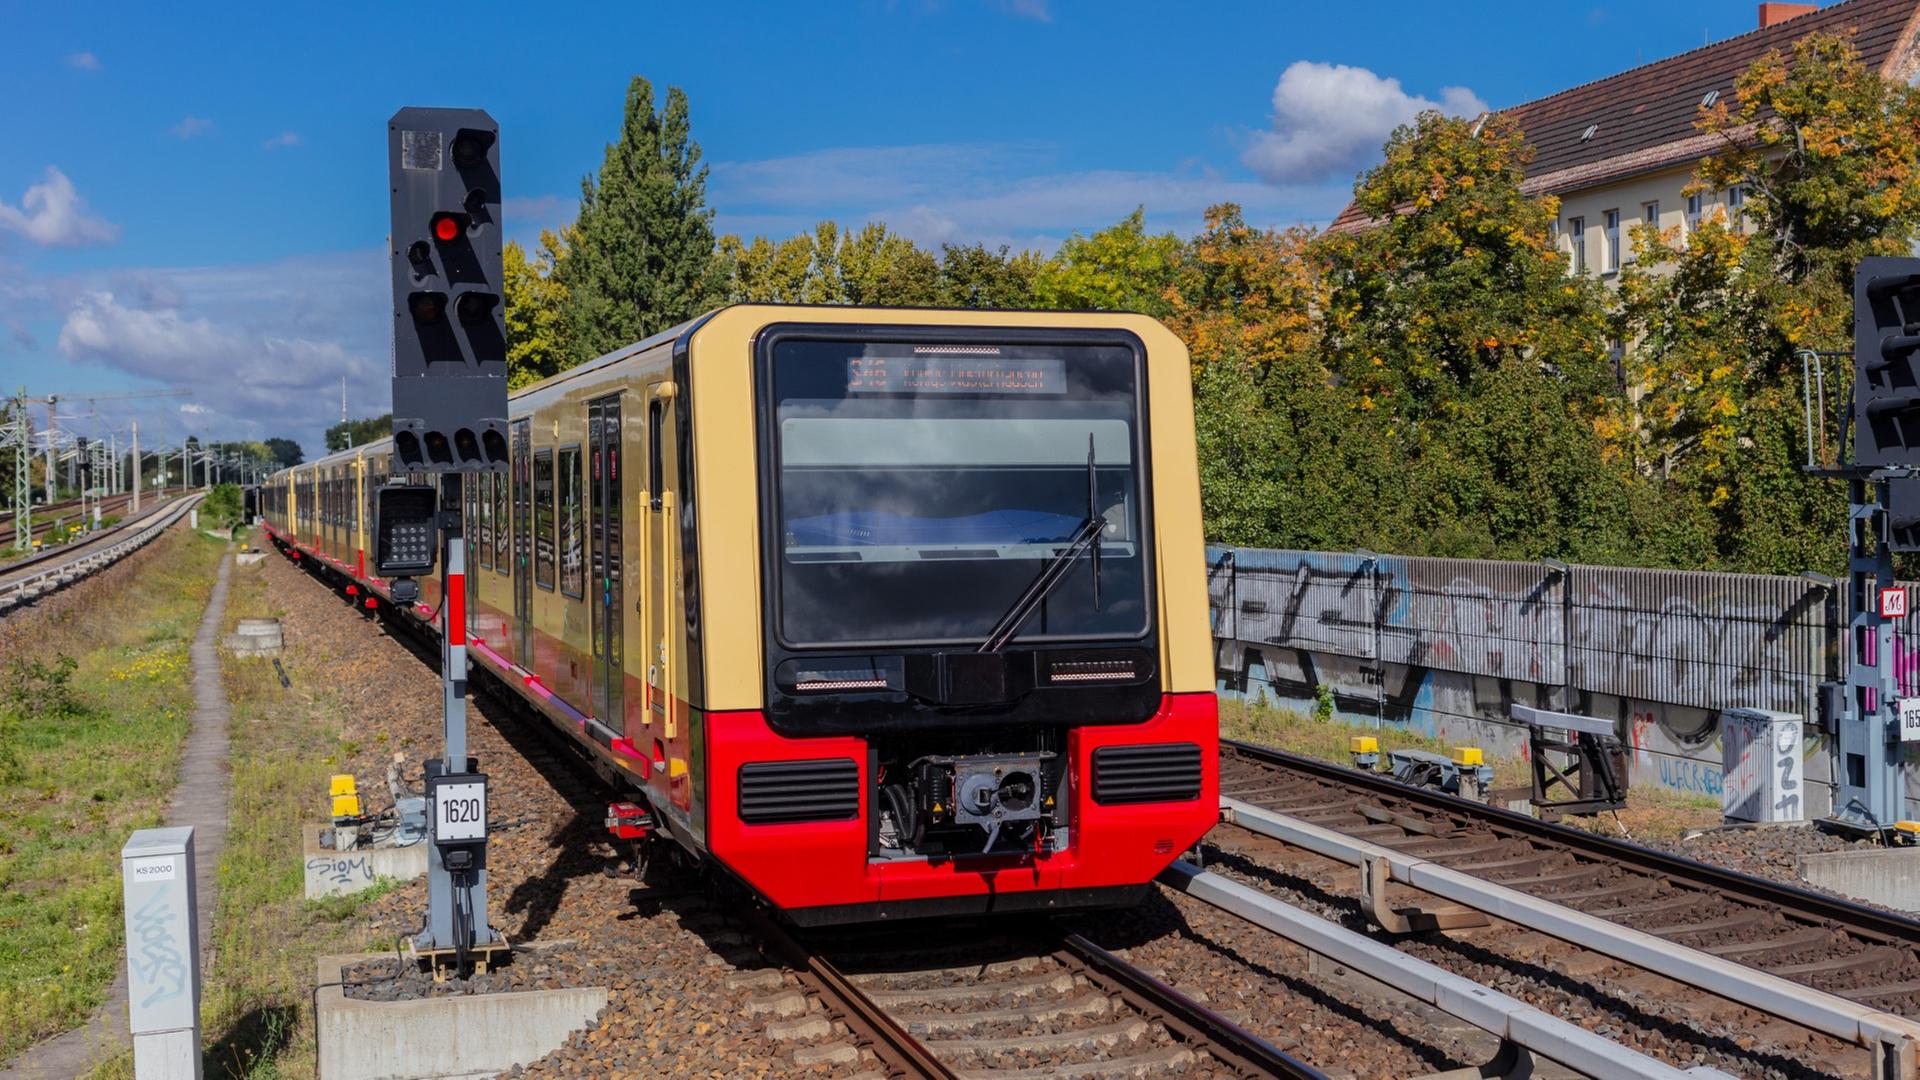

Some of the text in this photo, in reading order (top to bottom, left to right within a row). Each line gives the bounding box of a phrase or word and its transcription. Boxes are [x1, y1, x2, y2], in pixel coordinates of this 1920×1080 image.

[1885, 594, 1902, 611] M
[442, 798, 480, 823] 1620
[136, 864, 173, 875] KS 2000
